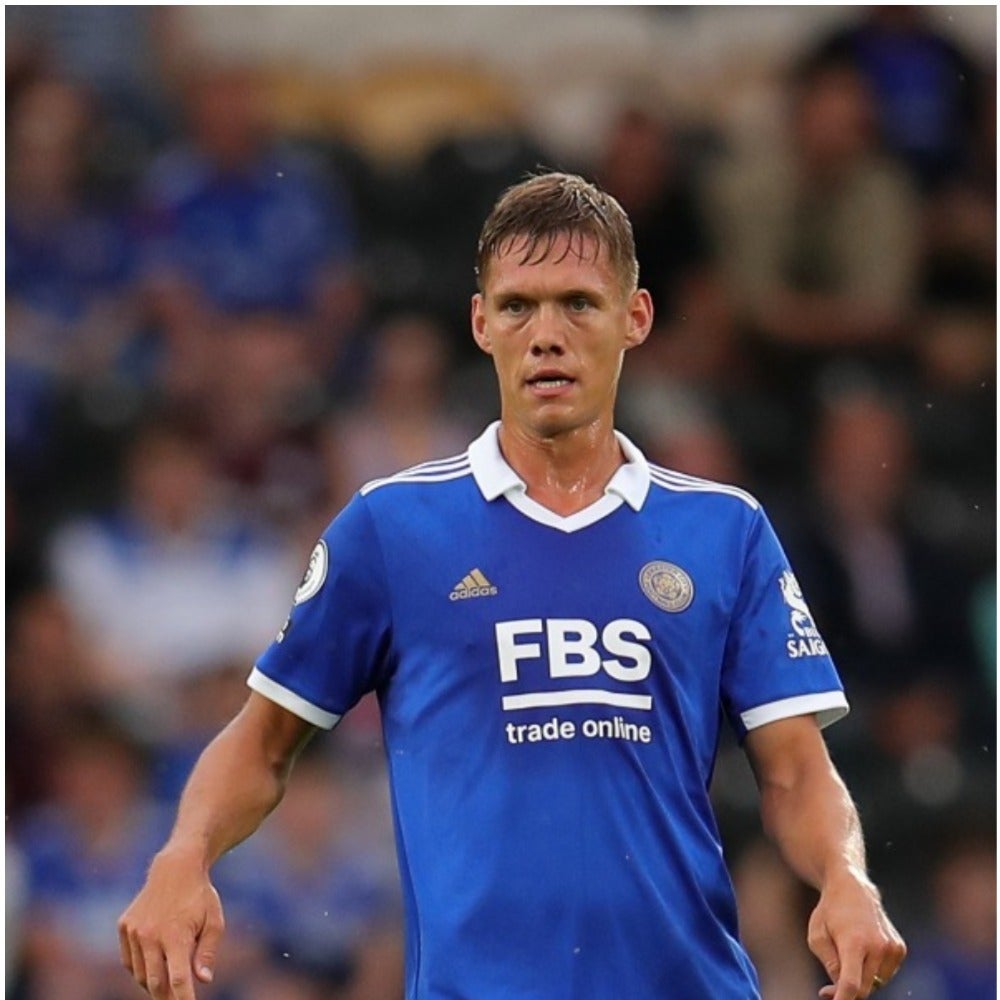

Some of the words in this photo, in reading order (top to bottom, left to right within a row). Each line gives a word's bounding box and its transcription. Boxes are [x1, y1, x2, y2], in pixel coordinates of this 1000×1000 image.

[449, 586, 498, 601] adidas
[496, 618, 652, 682] FBS
[506, 717, 576, 744] trade
[581, 717, 652, 744] online
